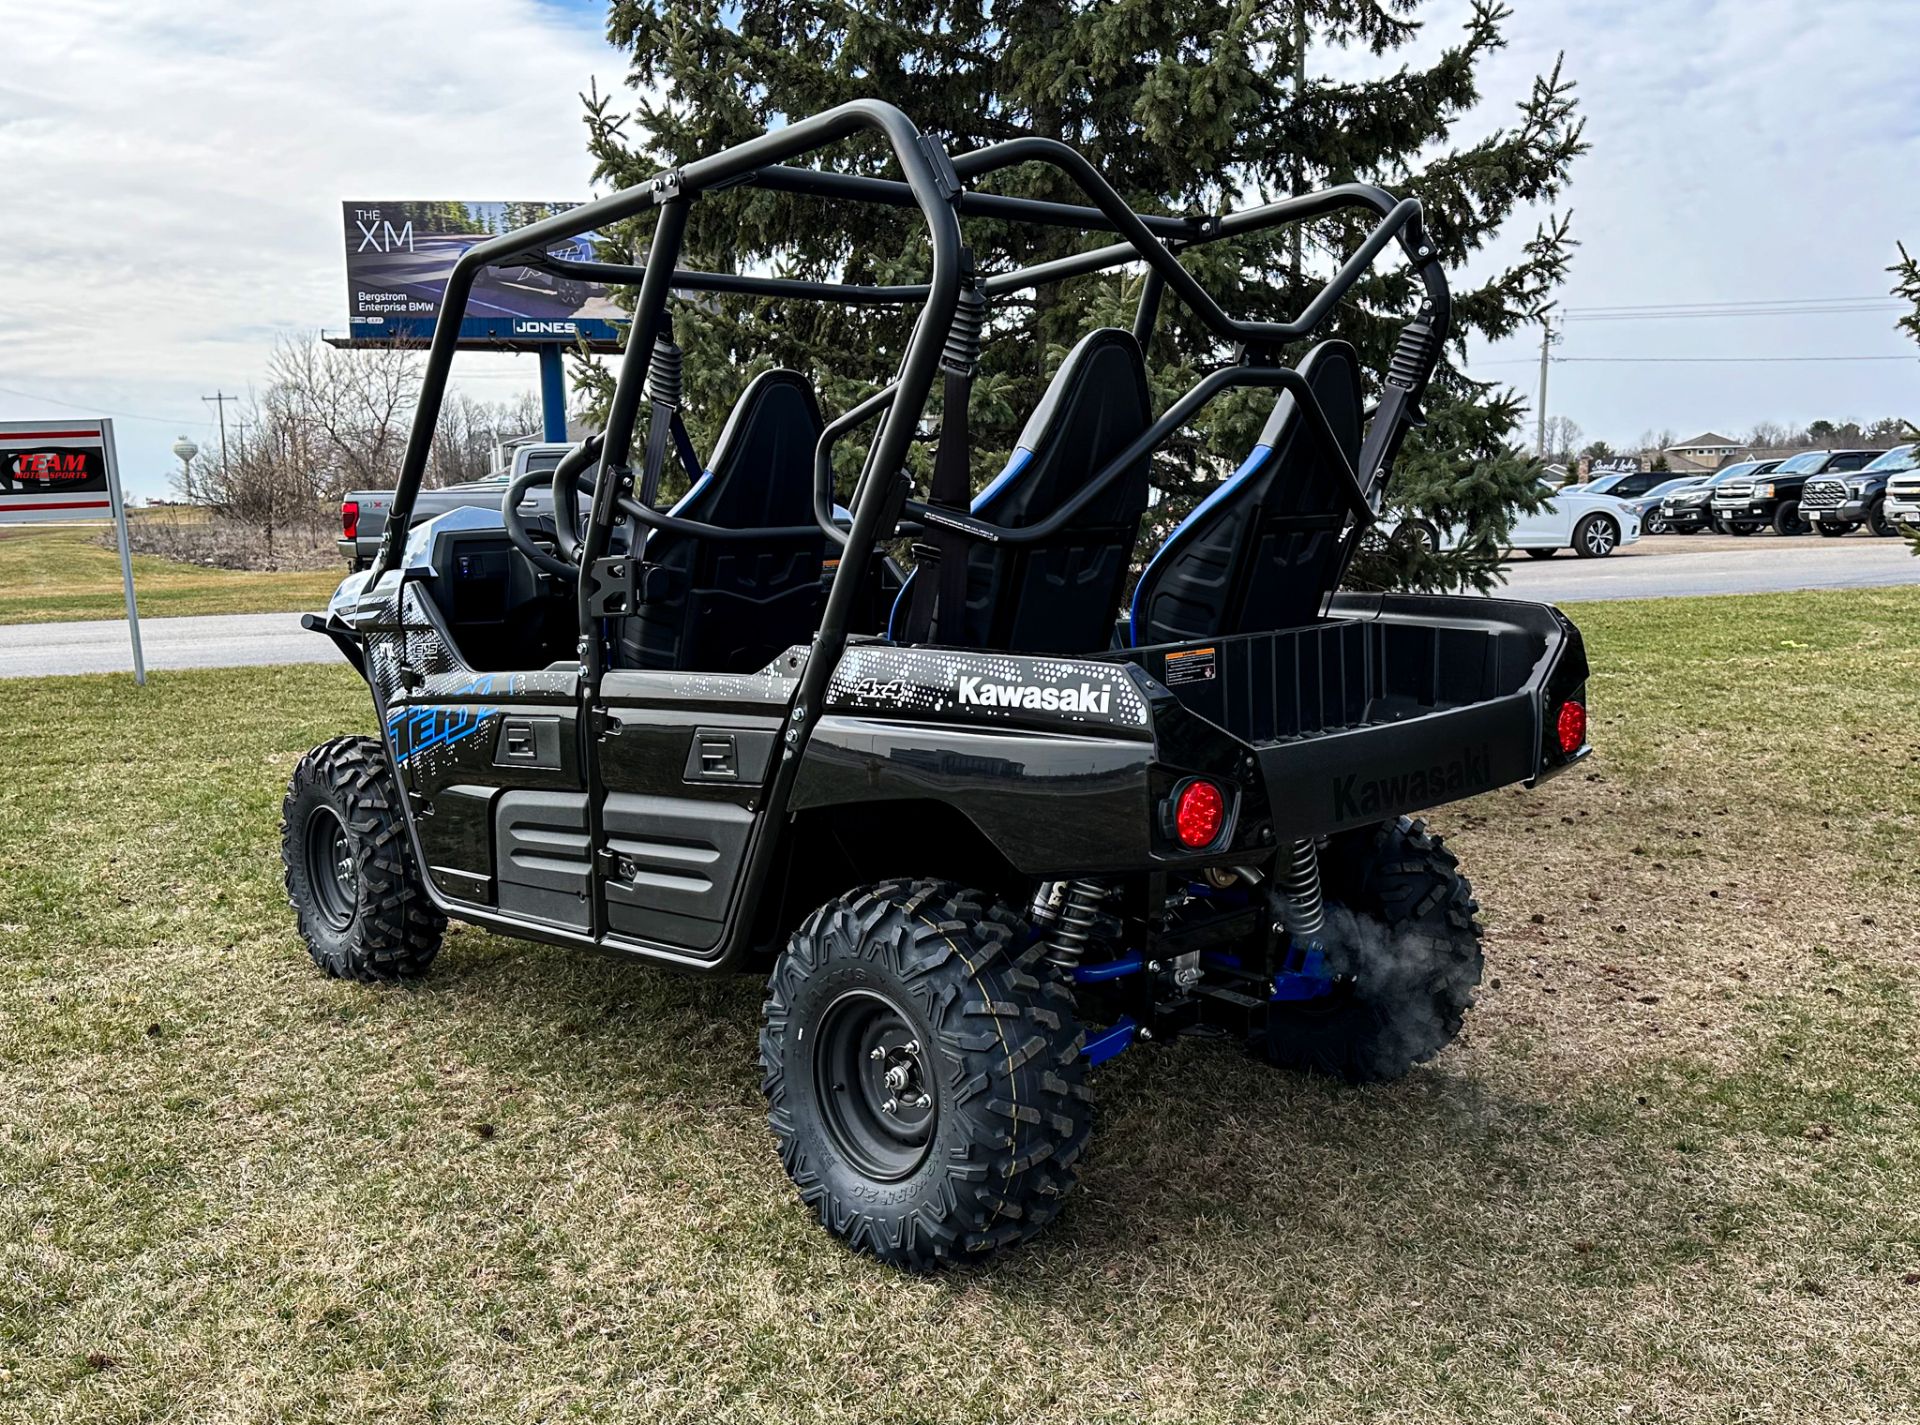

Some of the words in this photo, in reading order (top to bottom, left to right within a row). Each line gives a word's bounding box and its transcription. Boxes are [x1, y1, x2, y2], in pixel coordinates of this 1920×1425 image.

[355, 209, 381, 221] THE
[357, 220, 414, 253] XM
[358, 291, 407, 302] Bergstrom
[359, 302, 407, 313] Enterprise
[408, 302, 434, 312] BMW
[516, 321, 577, 334] JONES
[19, 454, 87, 471] TEAM
[14, 471, 88, 480] MOTORSPORTS
[958, 676, 1111, 714] Kawasaki
[1333, 743, 1491, 821] Kawasaki
